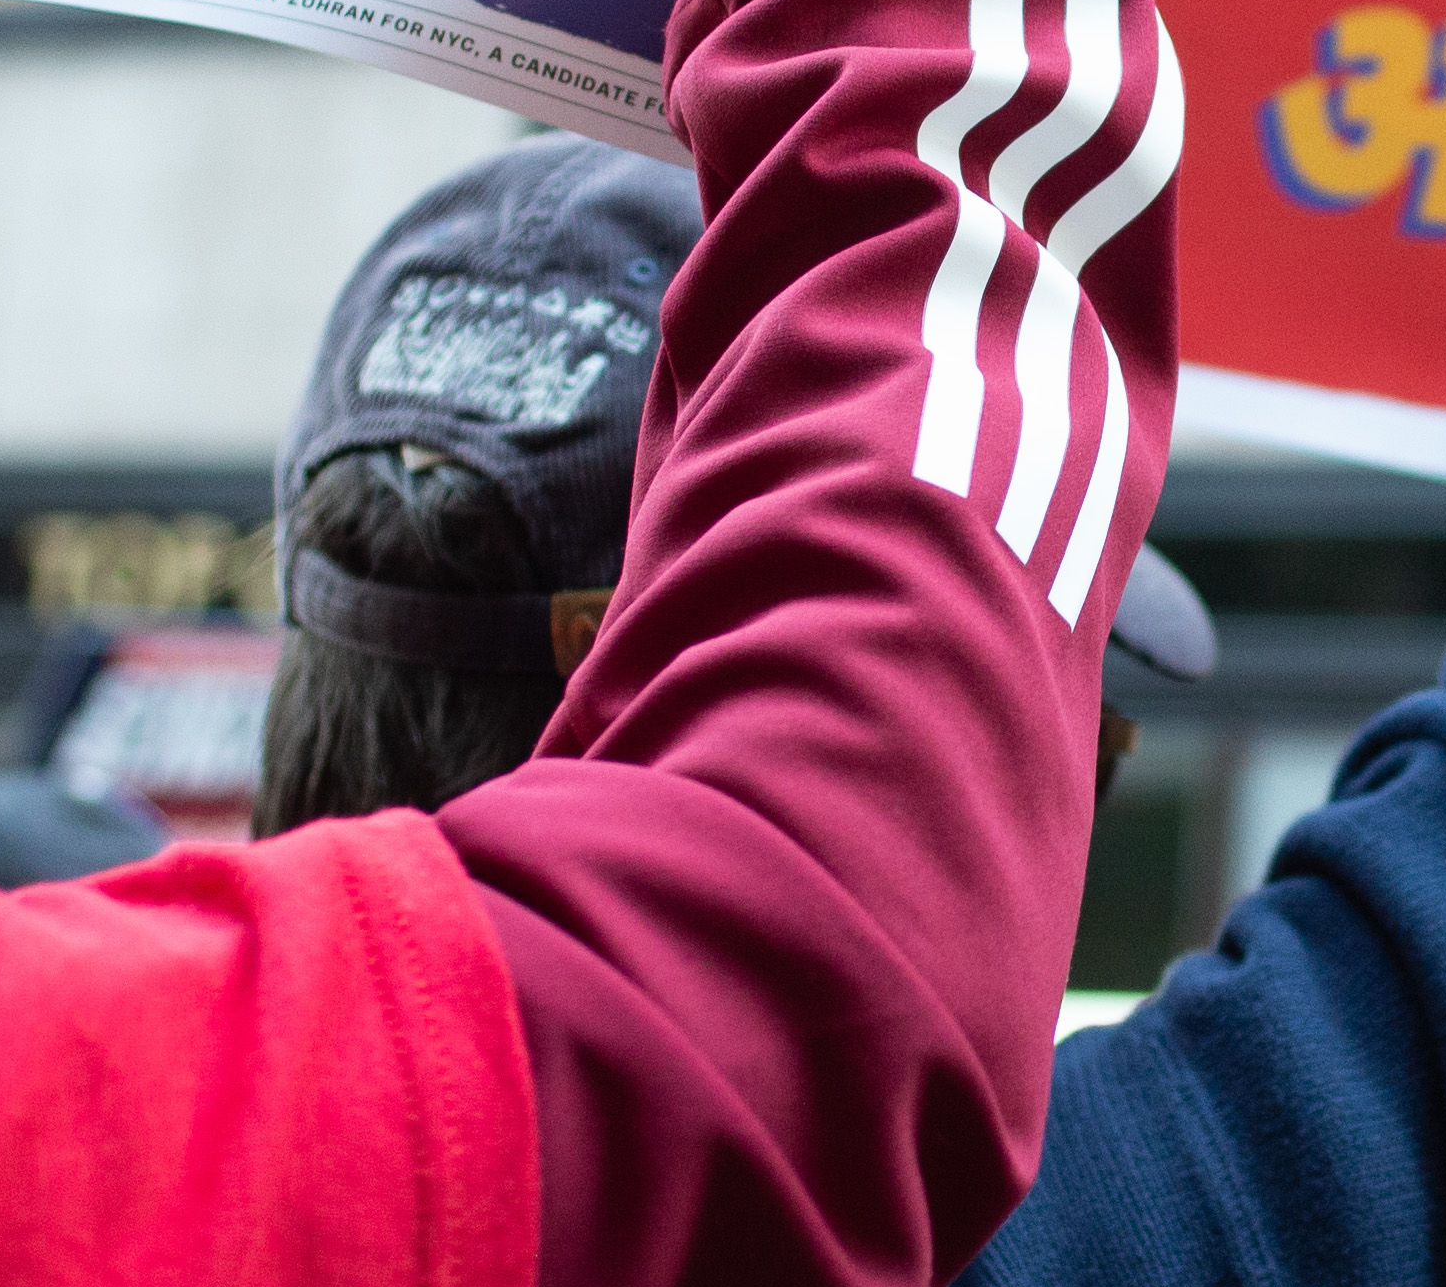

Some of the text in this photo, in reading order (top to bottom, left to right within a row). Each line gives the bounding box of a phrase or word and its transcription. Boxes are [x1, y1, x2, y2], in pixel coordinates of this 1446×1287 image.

[380, 13, 424, 38] FOR
[429, 26, 480, 58] NYC,
[487, 45, 503, 63] A
[510, 52, 640, 107] CANDIDATE
